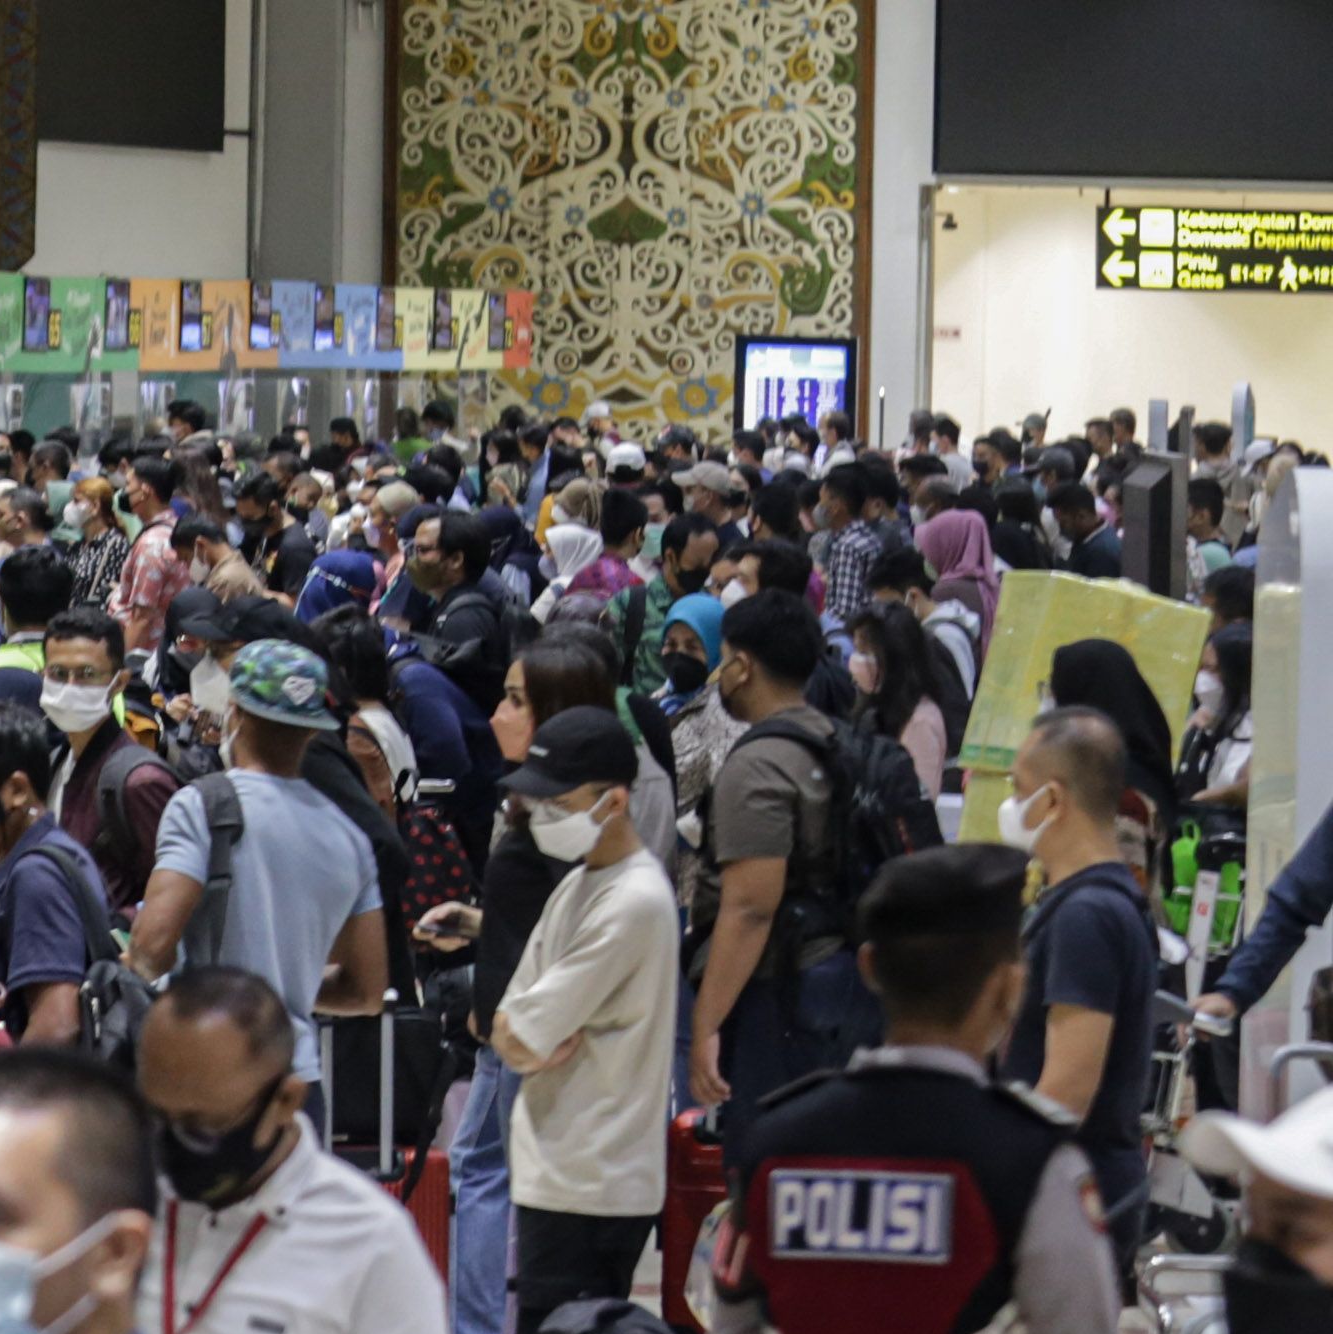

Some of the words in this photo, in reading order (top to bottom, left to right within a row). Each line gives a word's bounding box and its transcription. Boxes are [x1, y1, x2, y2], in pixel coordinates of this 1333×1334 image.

[1177, 209, 1296, 234] Keberangkatan
[1177, 228, 1251, 249] Domestic
[1254, 231, 1333, 253] Departure
[1177, 269, 1225, 290] Gates
[774, 1179, 942, 1253] POLISI
